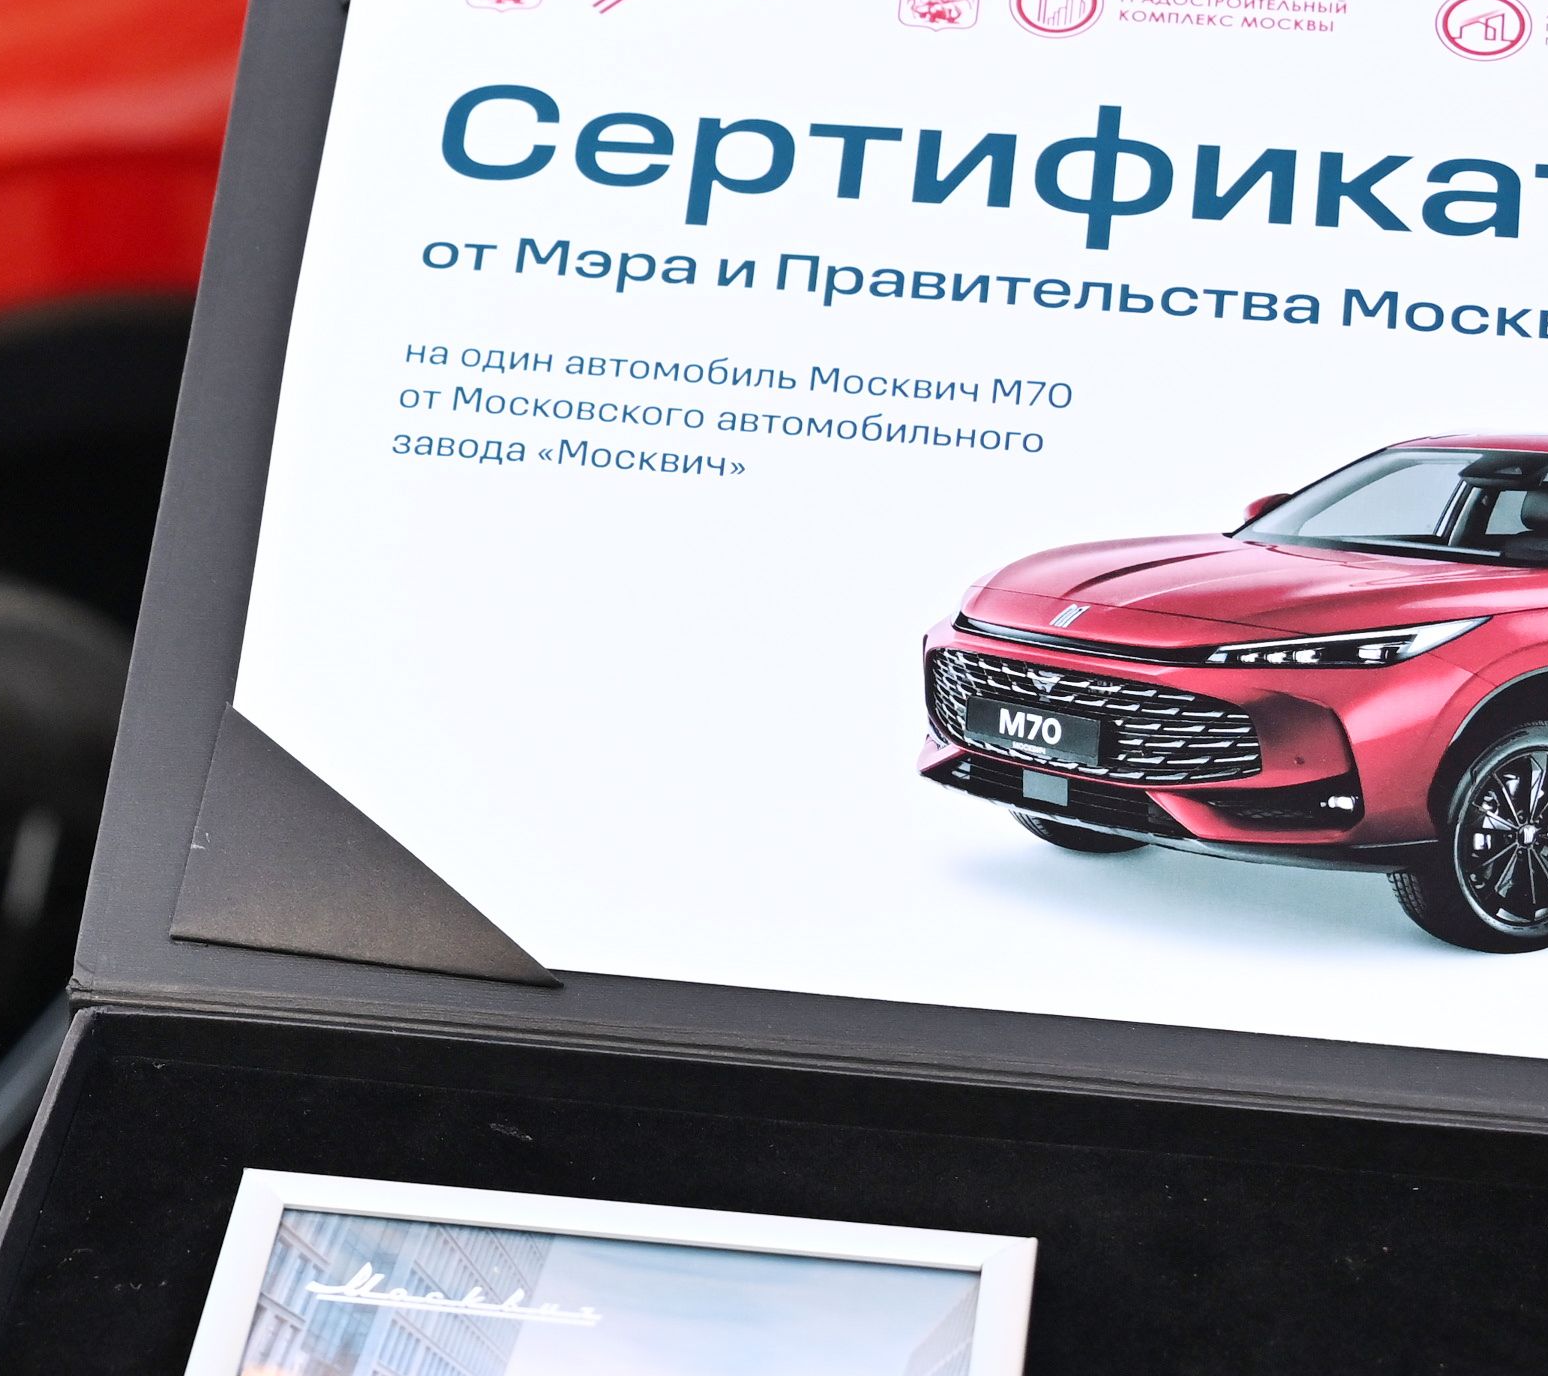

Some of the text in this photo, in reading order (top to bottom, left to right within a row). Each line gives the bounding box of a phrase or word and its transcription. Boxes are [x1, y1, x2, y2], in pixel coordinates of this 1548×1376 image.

[1119, 9, 1335, 32] КОМПЛЕКС МОСКВЫ
[422, 241, 498, 271] от
[514, 237, 698, 293] Мэра
[717, 258, 756, 288] и
[776, 253, 1321, 325] Правительства
[405, 344, 1073, 409] на один автомобиль Москвич М70
[399, 386, 1045, 453] от Московского автомобильного
[392, 434, 747, 477] завода «Москвич»
